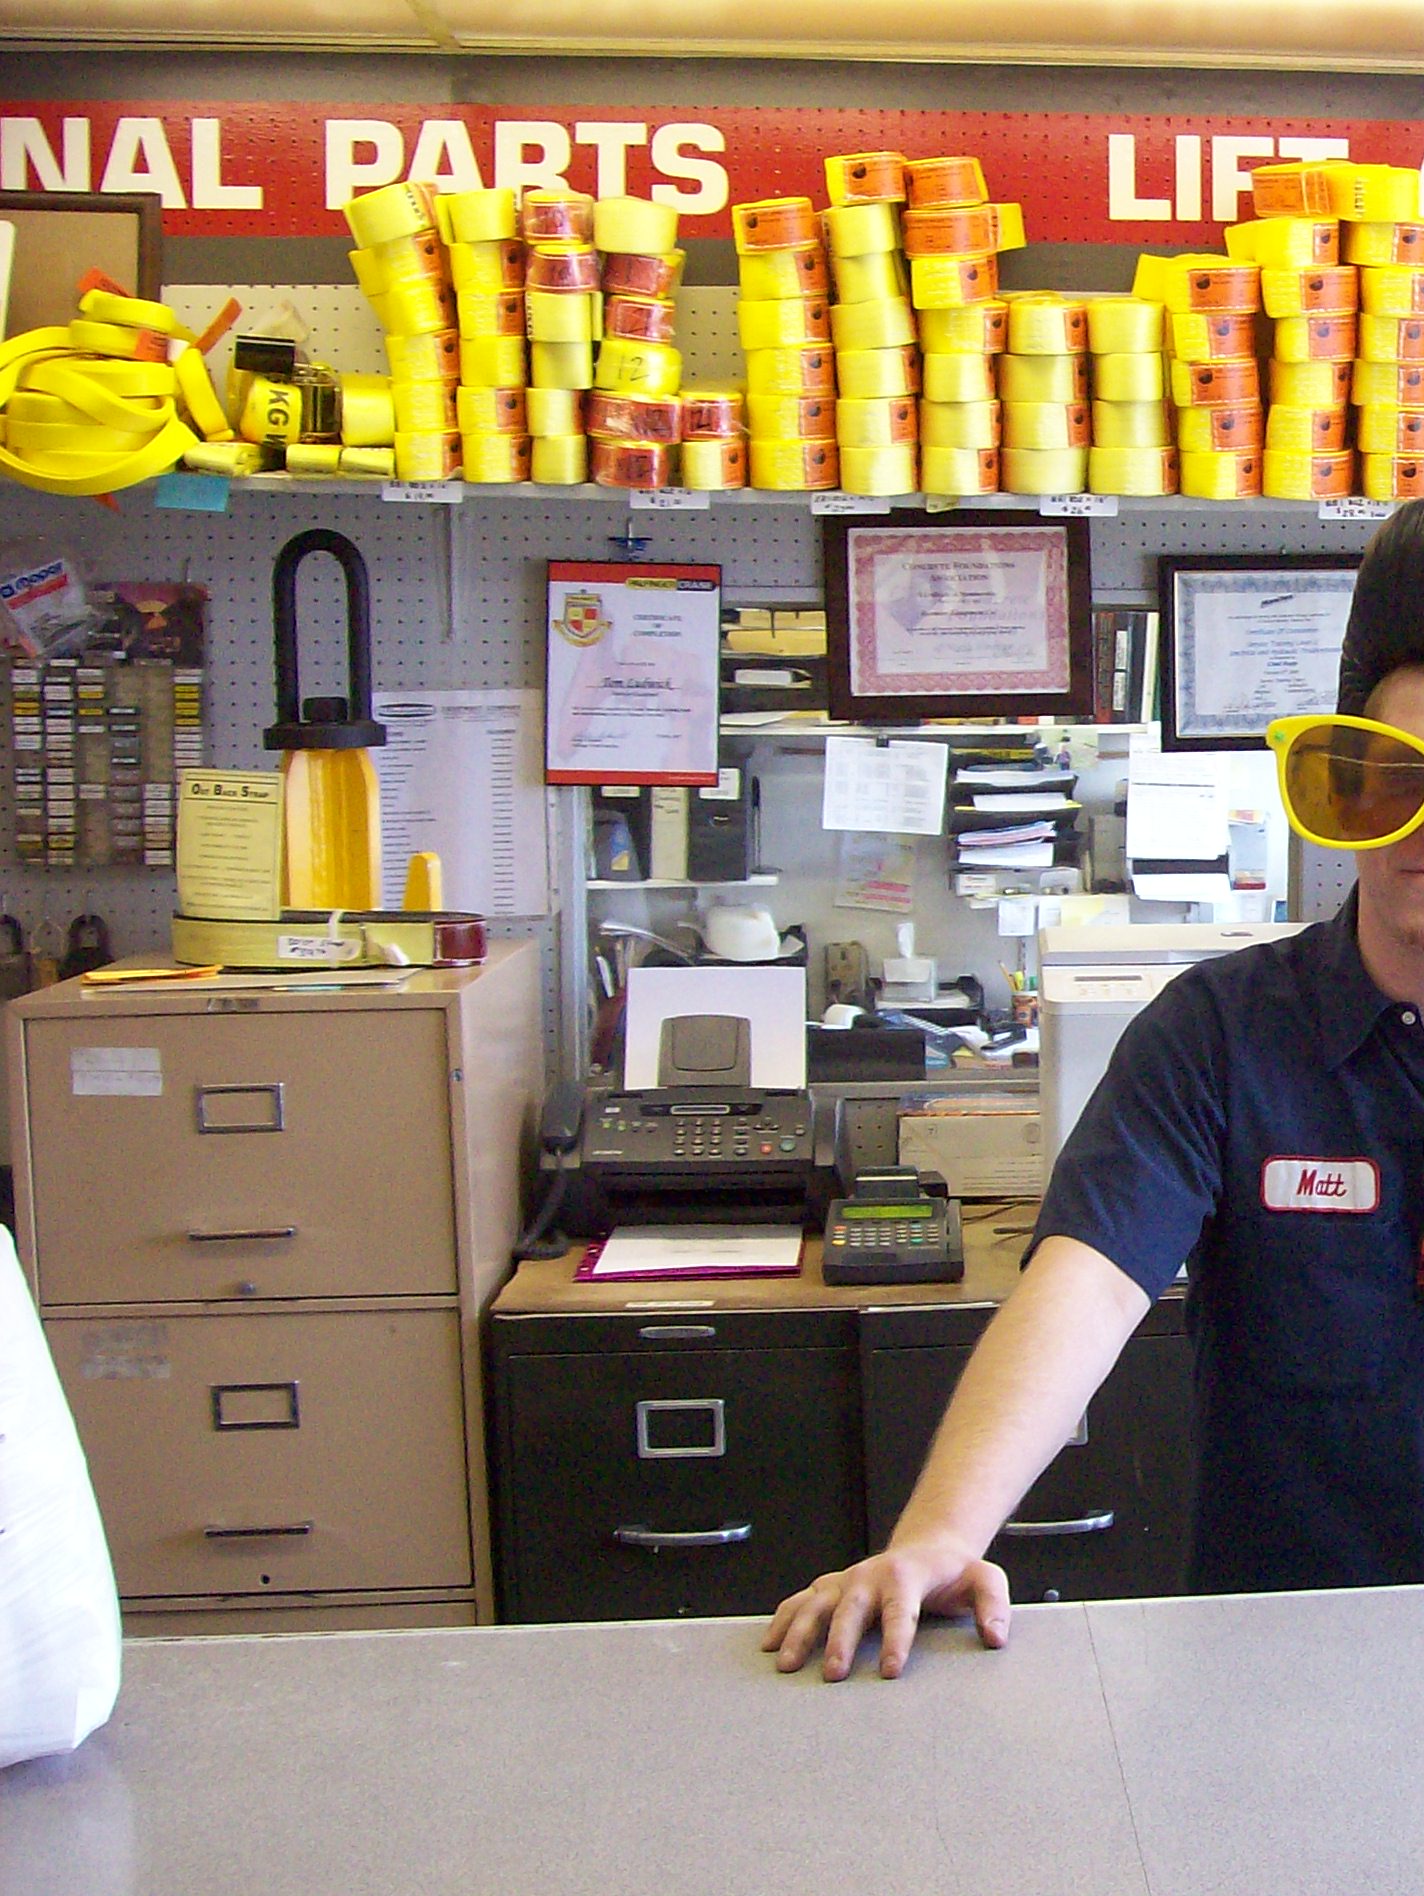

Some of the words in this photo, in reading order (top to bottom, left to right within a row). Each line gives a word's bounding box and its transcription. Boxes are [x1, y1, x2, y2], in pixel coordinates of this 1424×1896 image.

[325, 118, 729, 214] PARTS
[618, 356, 650, 381] 12
[267, 389, 290, 427] KG
[1295, 1169, 1348, 1197] Matt
